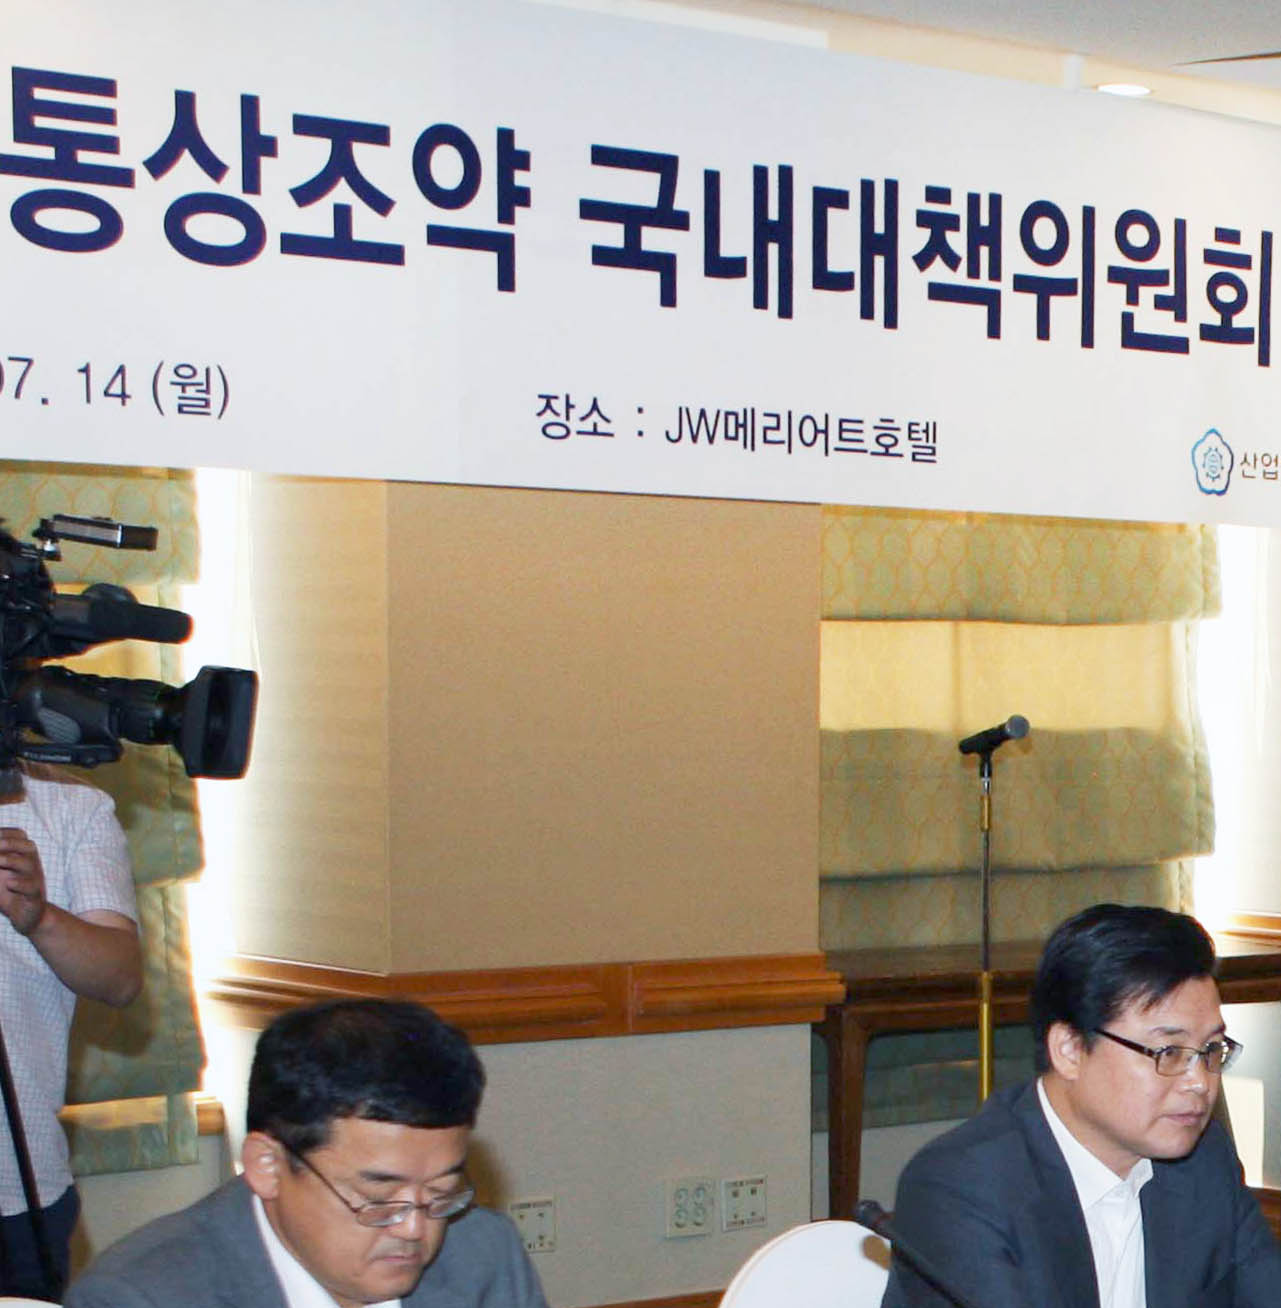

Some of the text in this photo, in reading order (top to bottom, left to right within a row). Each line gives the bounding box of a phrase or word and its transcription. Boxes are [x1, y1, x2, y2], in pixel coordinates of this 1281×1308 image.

[0, 65, 531, 292] 통상조약
[579, 144, 1274, 367] 국내대책위원회
[0, 356, 229, 419] 7. 14 (월)
[536, 393, 615, 440] 장소
[665, 405, 938, 463] JW메리어트호텔
